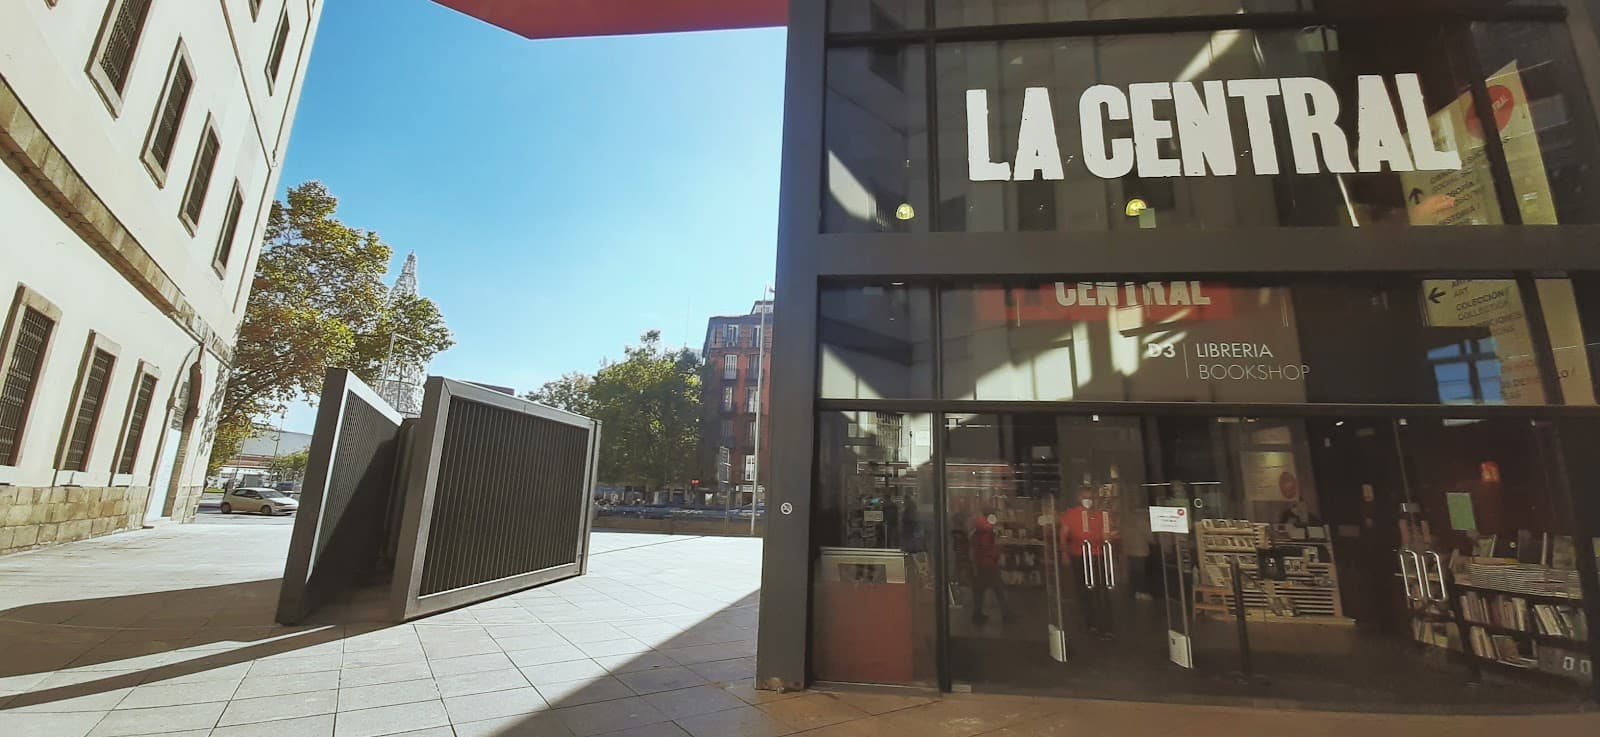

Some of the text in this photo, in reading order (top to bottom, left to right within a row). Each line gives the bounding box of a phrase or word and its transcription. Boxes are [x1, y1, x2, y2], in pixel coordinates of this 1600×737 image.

[966, 73, 1462, 181] LA CENTRAL
[1055, 281, 1212, 306] CENTRAL
[1147, 343, 1274, 358] D3 LIBRERIA
[1199, 364, 1311, 381] BOOKSHOP
